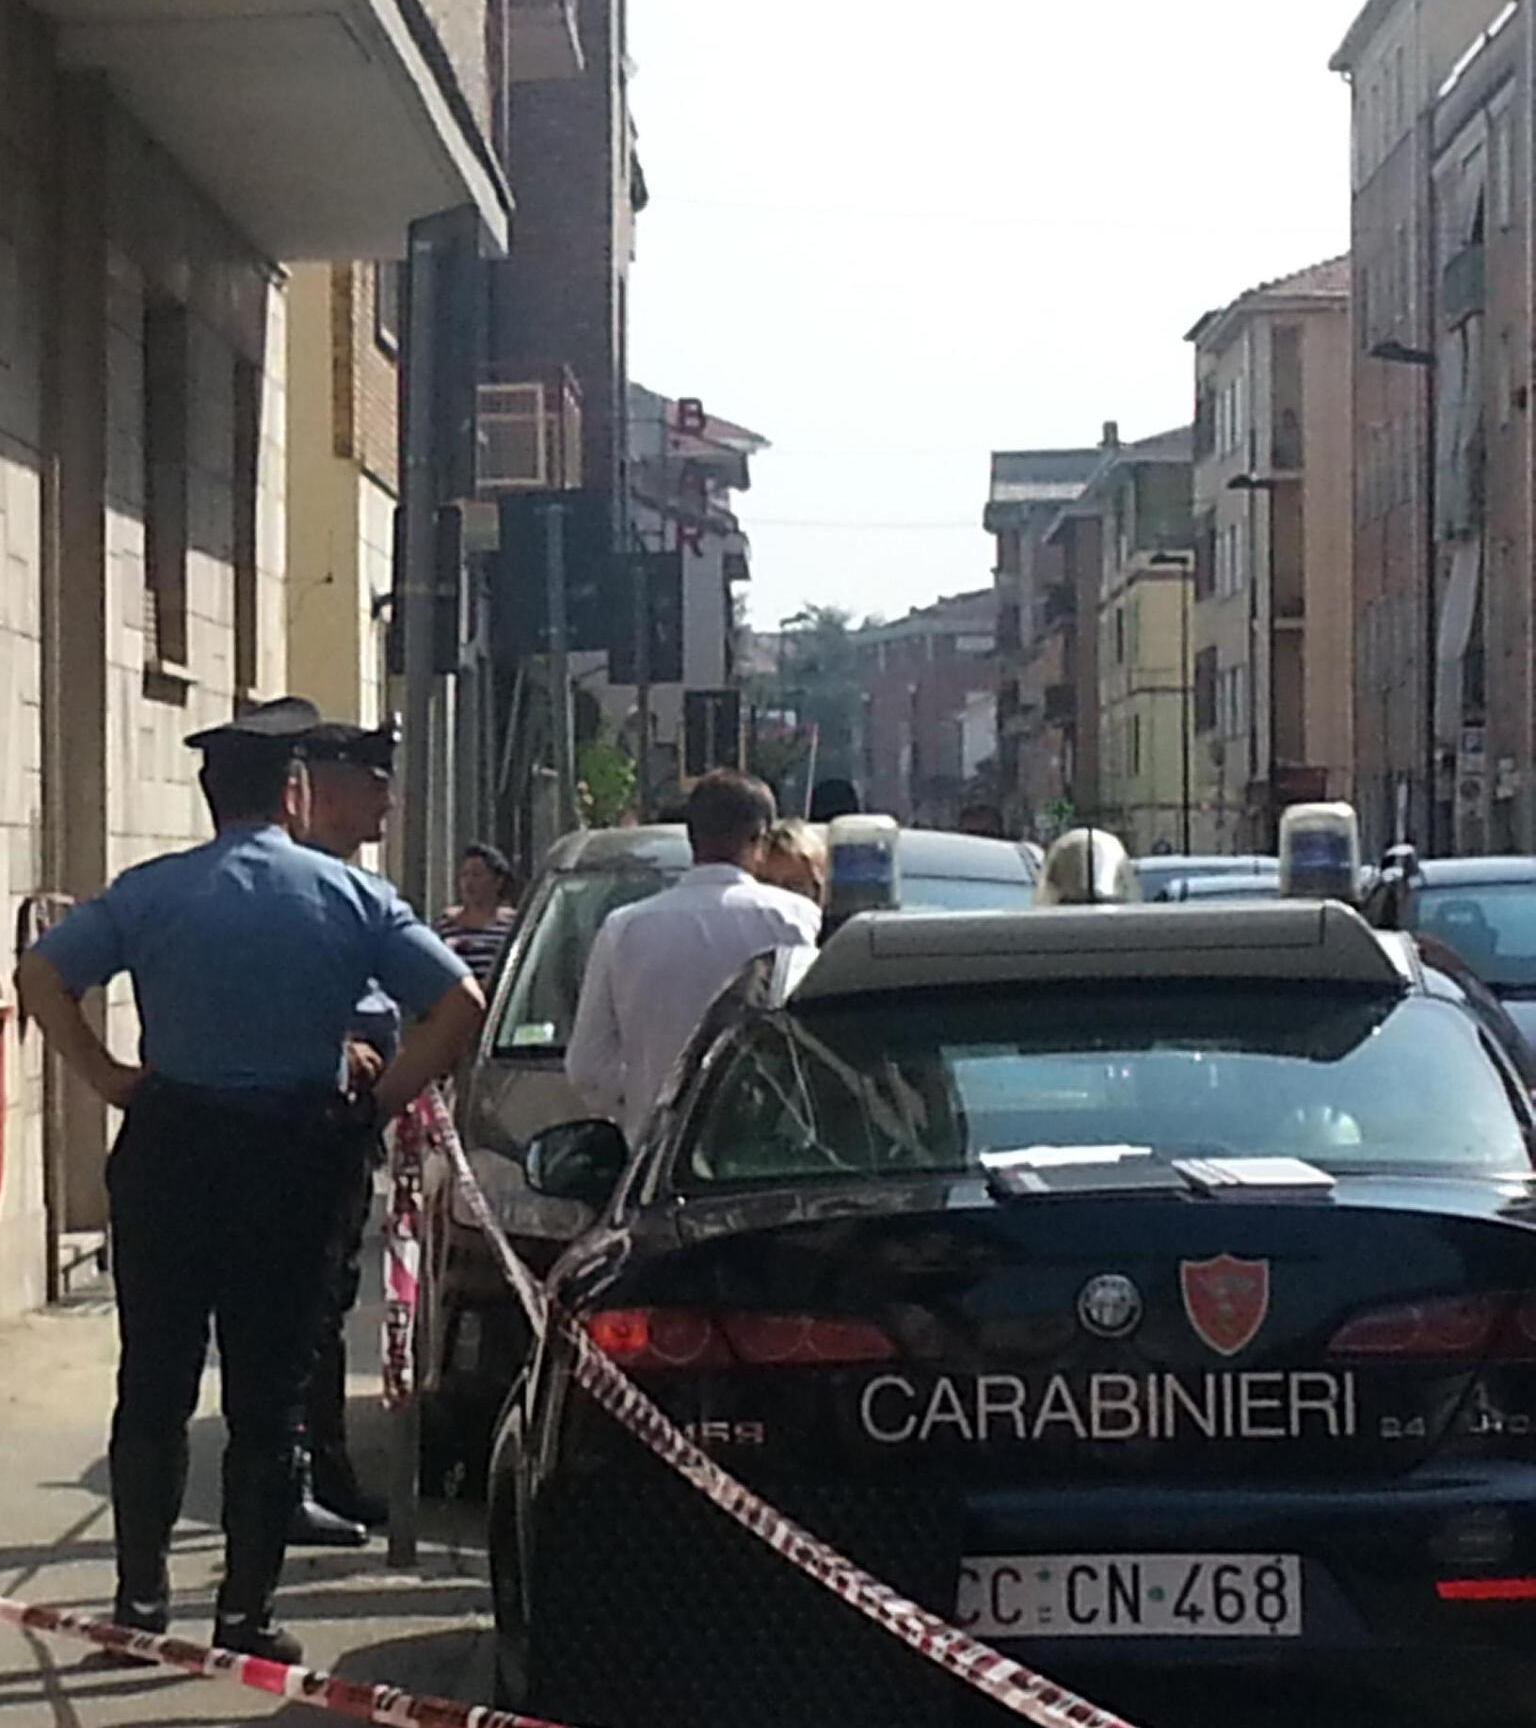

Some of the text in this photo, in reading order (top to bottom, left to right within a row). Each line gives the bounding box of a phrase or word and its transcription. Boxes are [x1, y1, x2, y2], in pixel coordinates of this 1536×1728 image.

[860, 1371, 1356, 1443] CARABINIERI
[1065, 1562, 1142, 1625] CN
[1171, 1561, 1289, 1626] 468
